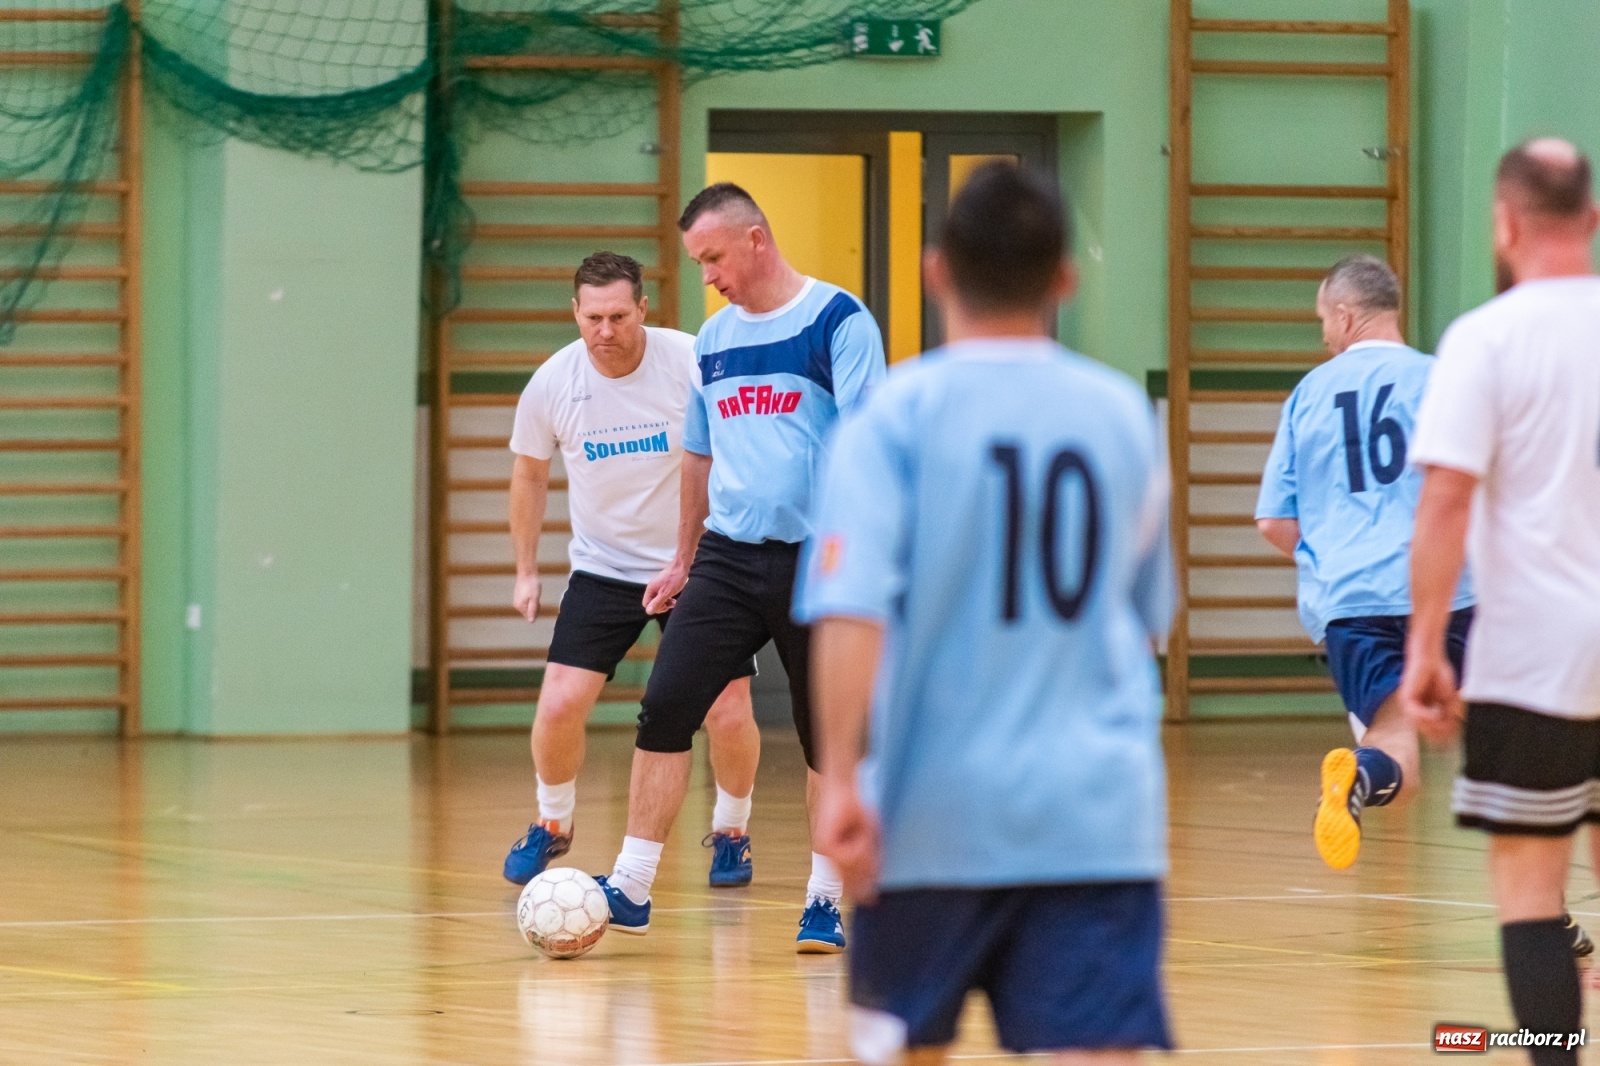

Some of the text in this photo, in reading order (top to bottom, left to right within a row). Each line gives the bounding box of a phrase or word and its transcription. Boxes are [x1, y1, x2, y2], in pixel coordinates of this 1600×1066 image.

[717, 385, 802, 419] RAFAKO
[1334, 383, 1407, 493] 16
[583, 431, 669, 462] SOLIDUM
[990, 443, 1100, 621] 10
